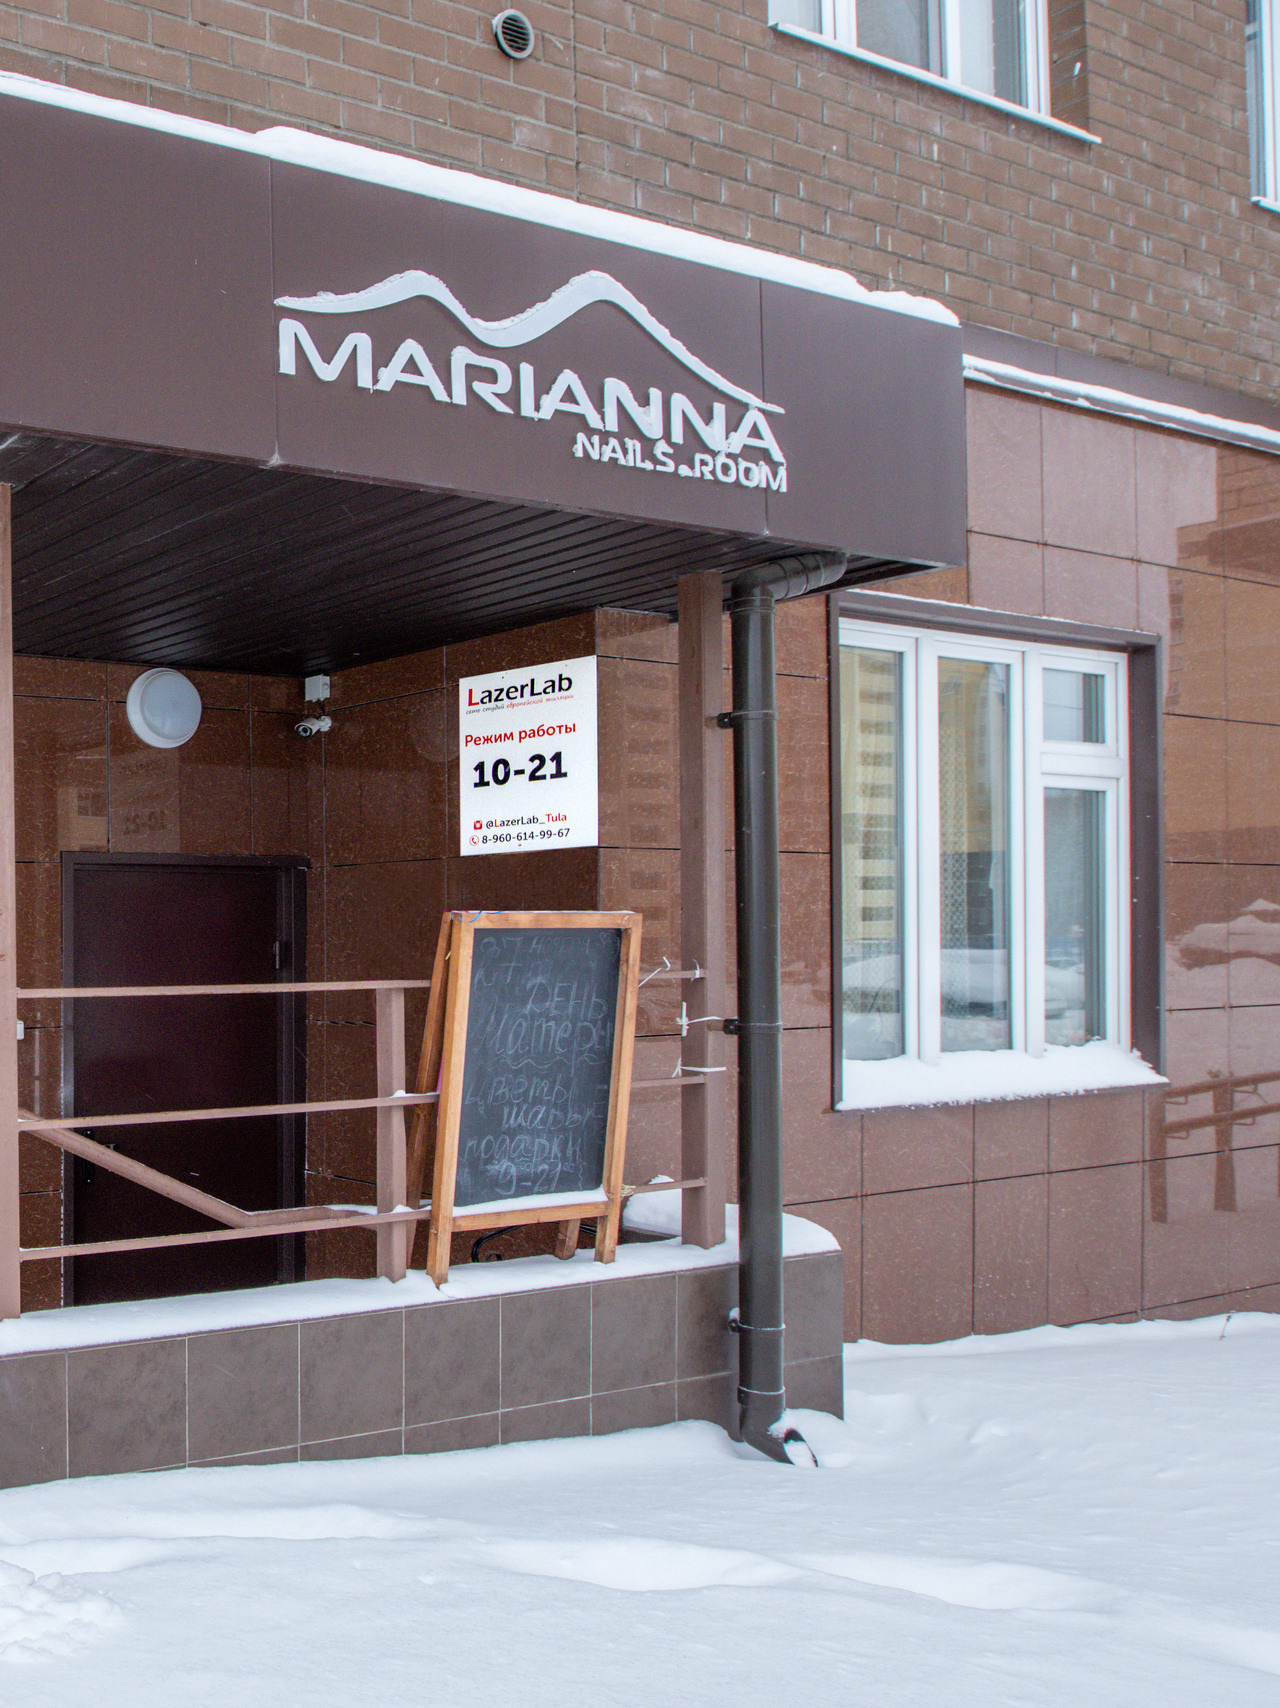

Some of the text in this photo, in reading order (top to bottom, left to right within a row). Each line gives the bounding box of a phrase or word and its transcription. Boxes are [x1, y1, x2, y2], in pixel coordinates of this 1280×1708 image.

[278, 318, 786, 464] MARIANNA
[468, 673, 573, 707] LazerLab
[465, 723, 576, 748] Режим работы
[472, 751, 568, 788] 10-21
[486, 812, 567, 829] @LazerLab_Tula
[481, 827, 571, 844] 8-960-614-99-67
